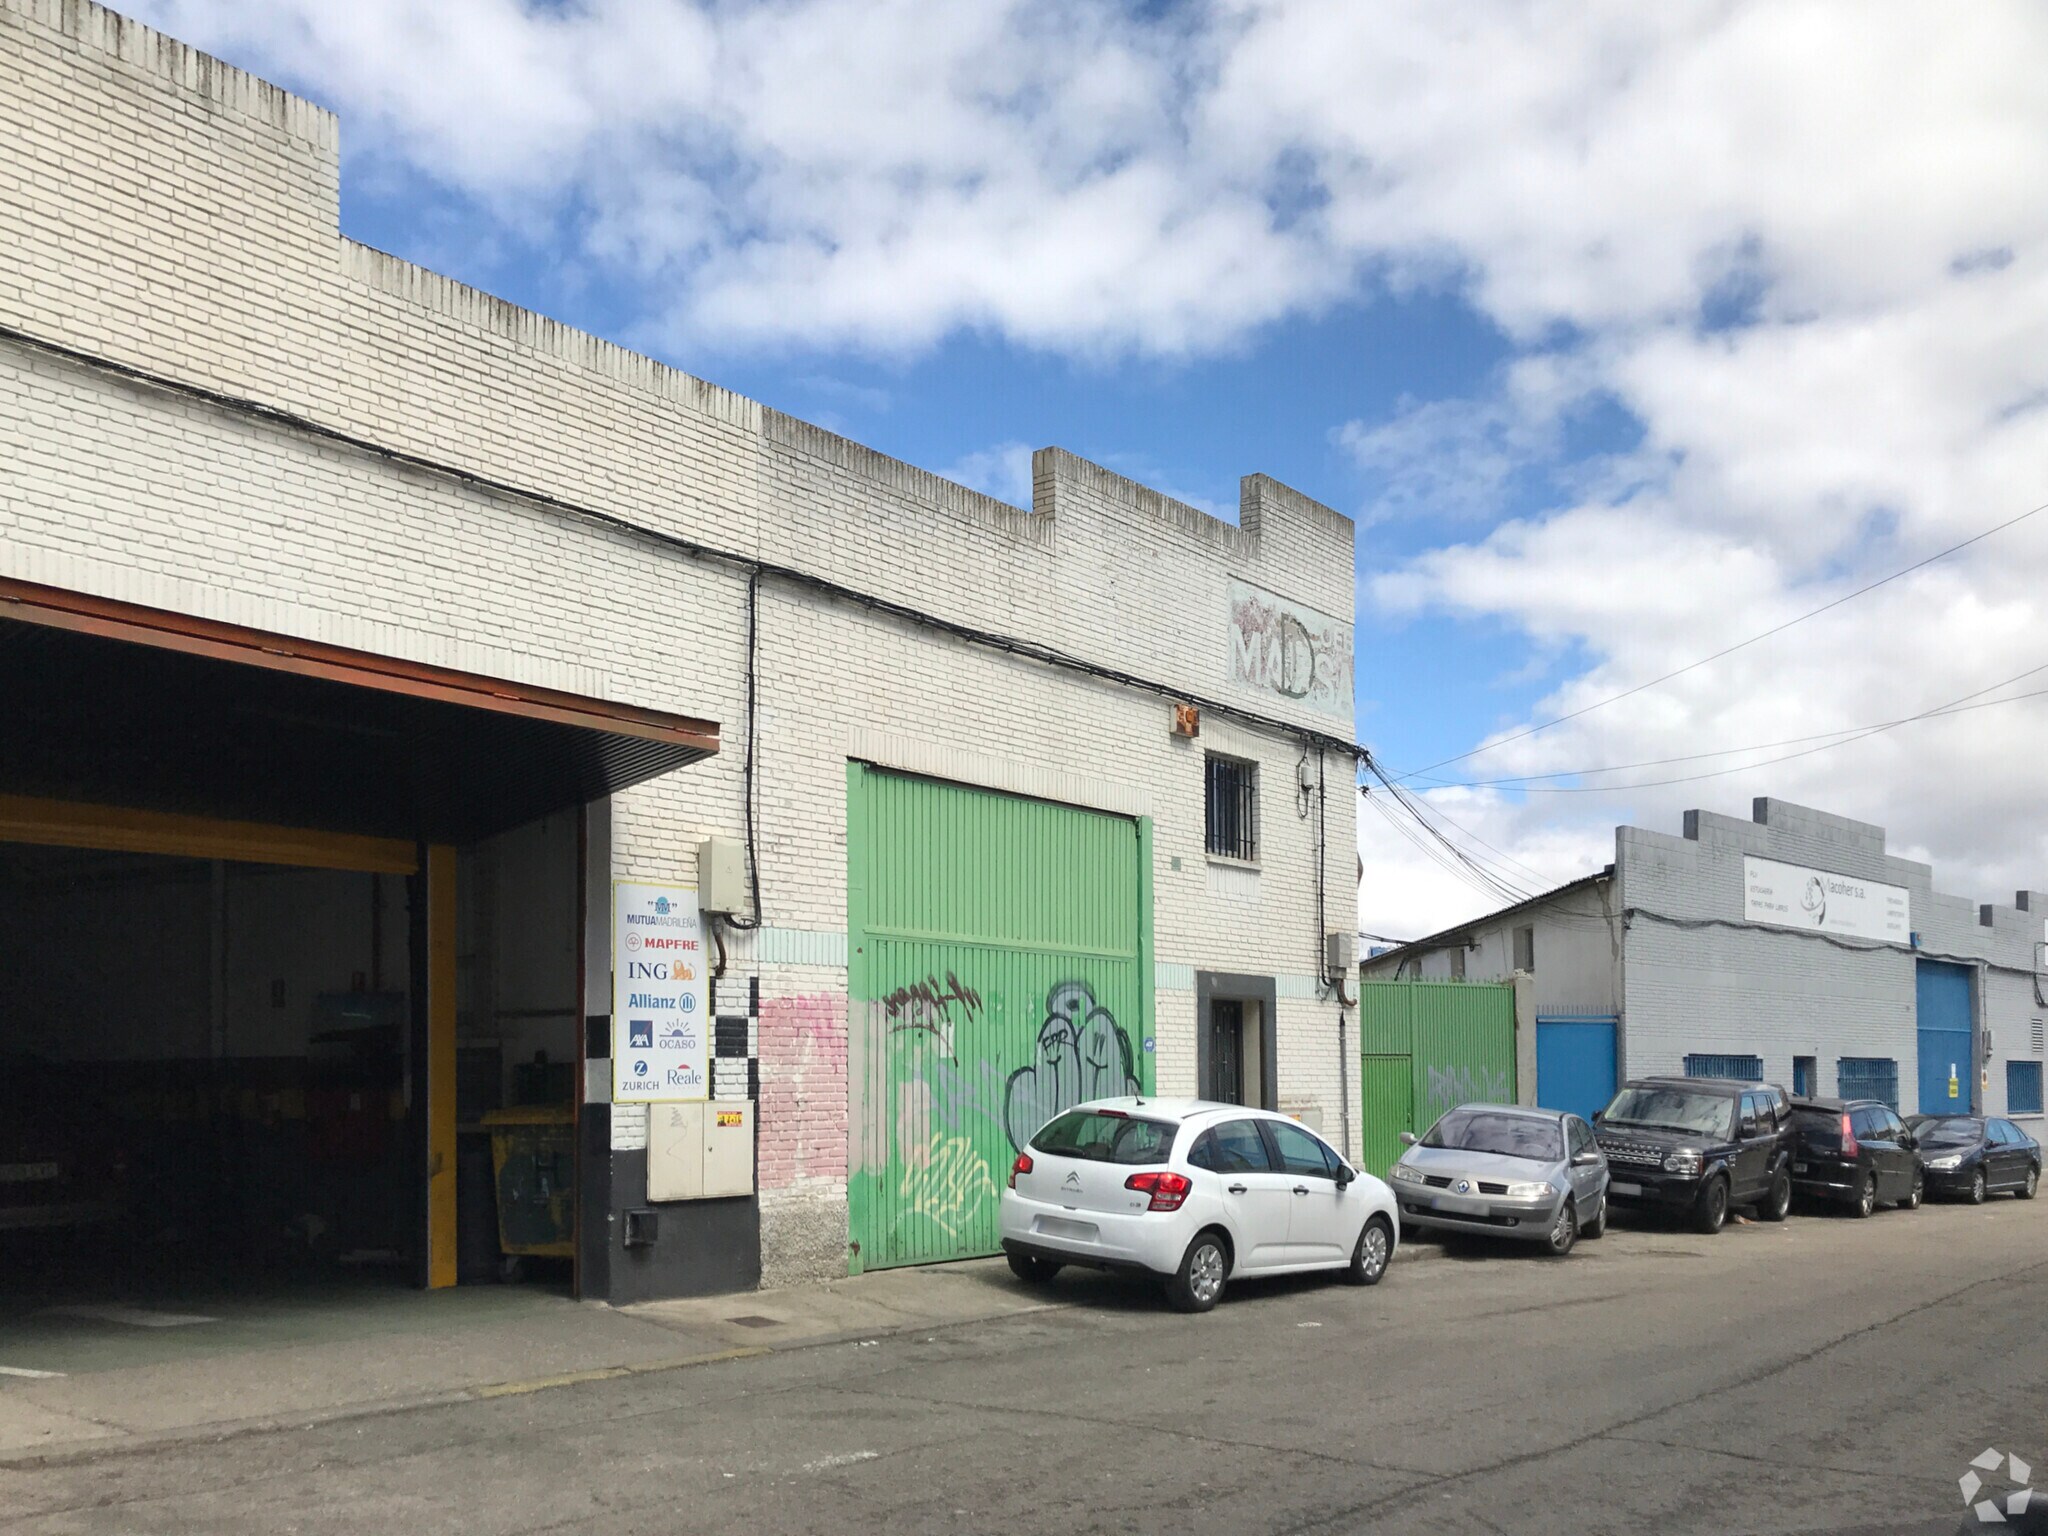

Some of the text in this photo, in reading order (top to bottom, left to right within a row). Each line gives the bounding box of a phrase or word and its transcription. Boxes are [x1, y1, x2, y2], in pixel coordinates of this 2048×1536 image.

[627, 914, 697, 928] MUTUAMADRILEÑA
[645, 938, 699, 951] MAPFRE
[628, 962, 668, 980] ING
[628, 993, 676, 1009] Allianz
[630, 1034, 649, 1047] AXA
[659, 1039, 696, 1049] OCASO
[667, 1069, 702, 1085] Reale
[622, 1081, 660, 1091] ZURICH
